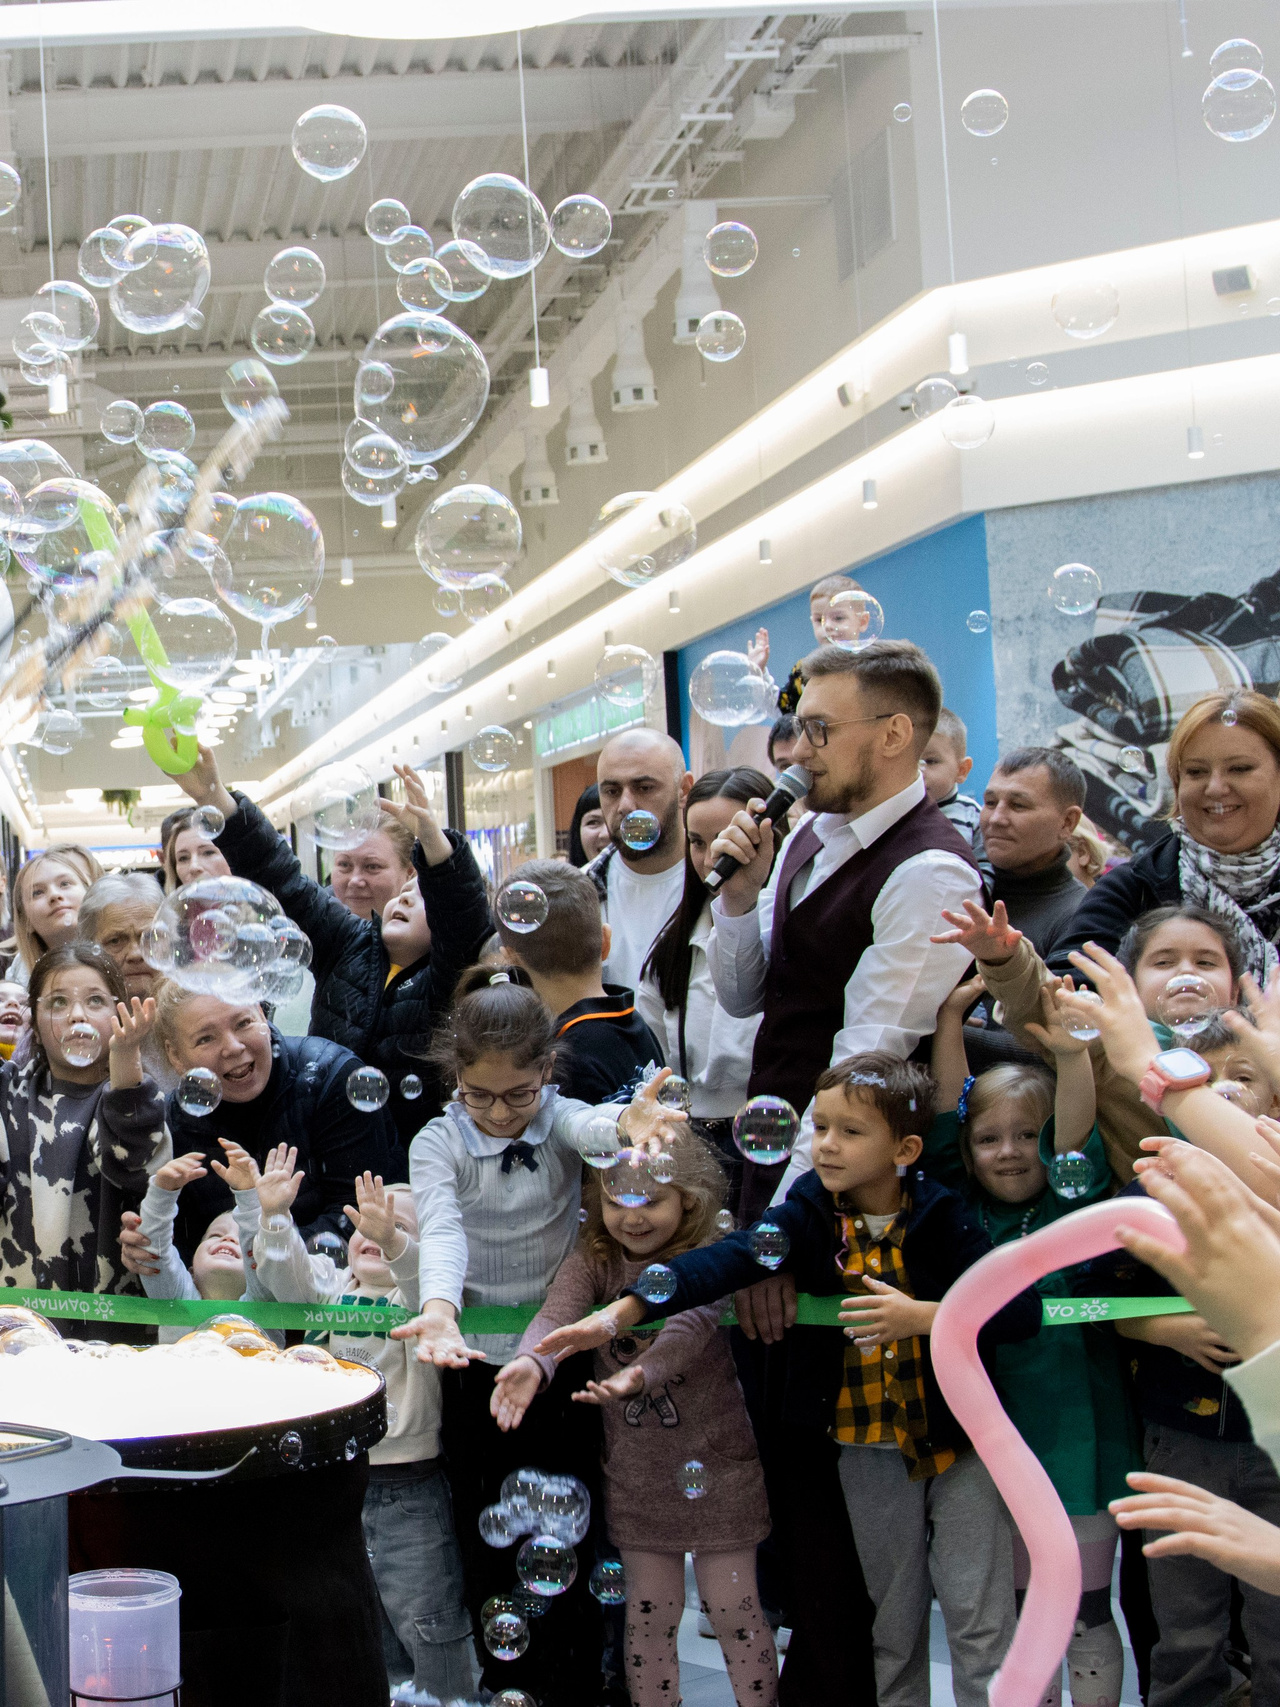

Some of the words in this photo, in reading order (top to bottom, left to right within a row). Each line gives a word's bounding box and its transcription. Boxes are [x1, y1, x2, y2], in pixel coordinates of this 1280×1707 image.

[22, 1297, 90, 1313] ОДИПАРК
[1046, 1304, 1075, 1318] ОД
[303, 1310, 385, 1325] ОДИПАРК
